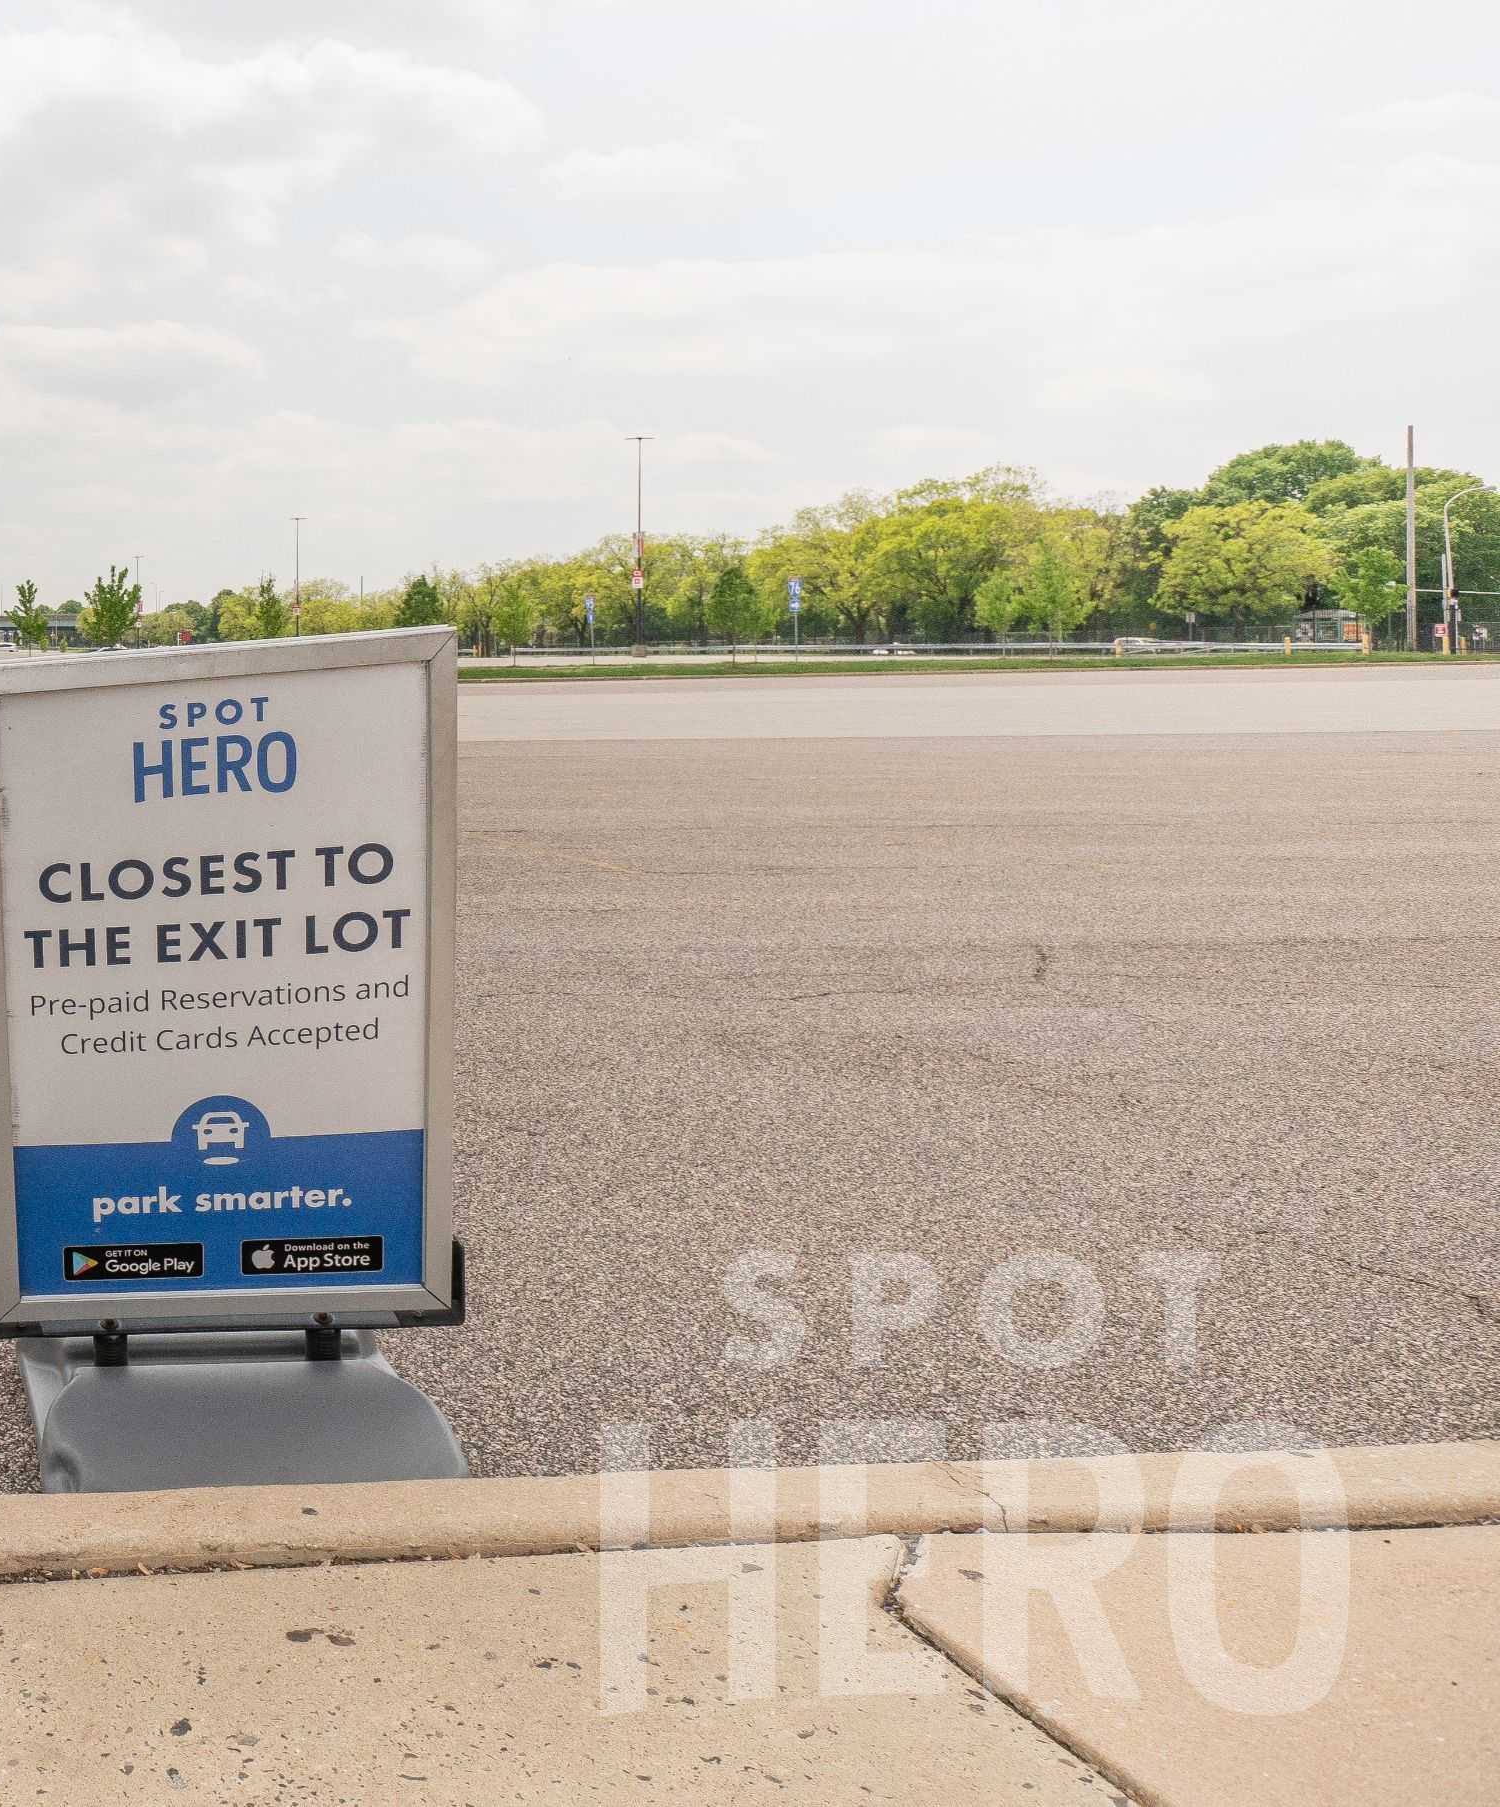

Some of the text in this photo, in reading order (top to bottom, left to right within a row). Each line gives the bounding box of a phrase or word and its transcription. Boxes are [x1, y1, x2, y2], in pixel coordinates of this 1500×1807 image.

[788, 581, 801, 595] 76
[158, 696, 270, 730] SPOT
[132, 730, 298, 803] HERO
[38, 842, 395, 904] CLOSEST TO
[24, 908, 411, 969] THE EXIT LOT
[30, 975, 410, 1020] Pre-paid Reservations and
[60, 1017, 380, 1055] Credit Cards Accepted
[92, 1186, 353, 1222] park smarter.
[105, 1249, 148, 1258] GET IT ON
[283, 1253, 371, 1271] App Store
[284, 1242, 335, 1252] Download
[353, 1241, 370, 1249] the
[105, 1257, 195, 1275] Google Play
